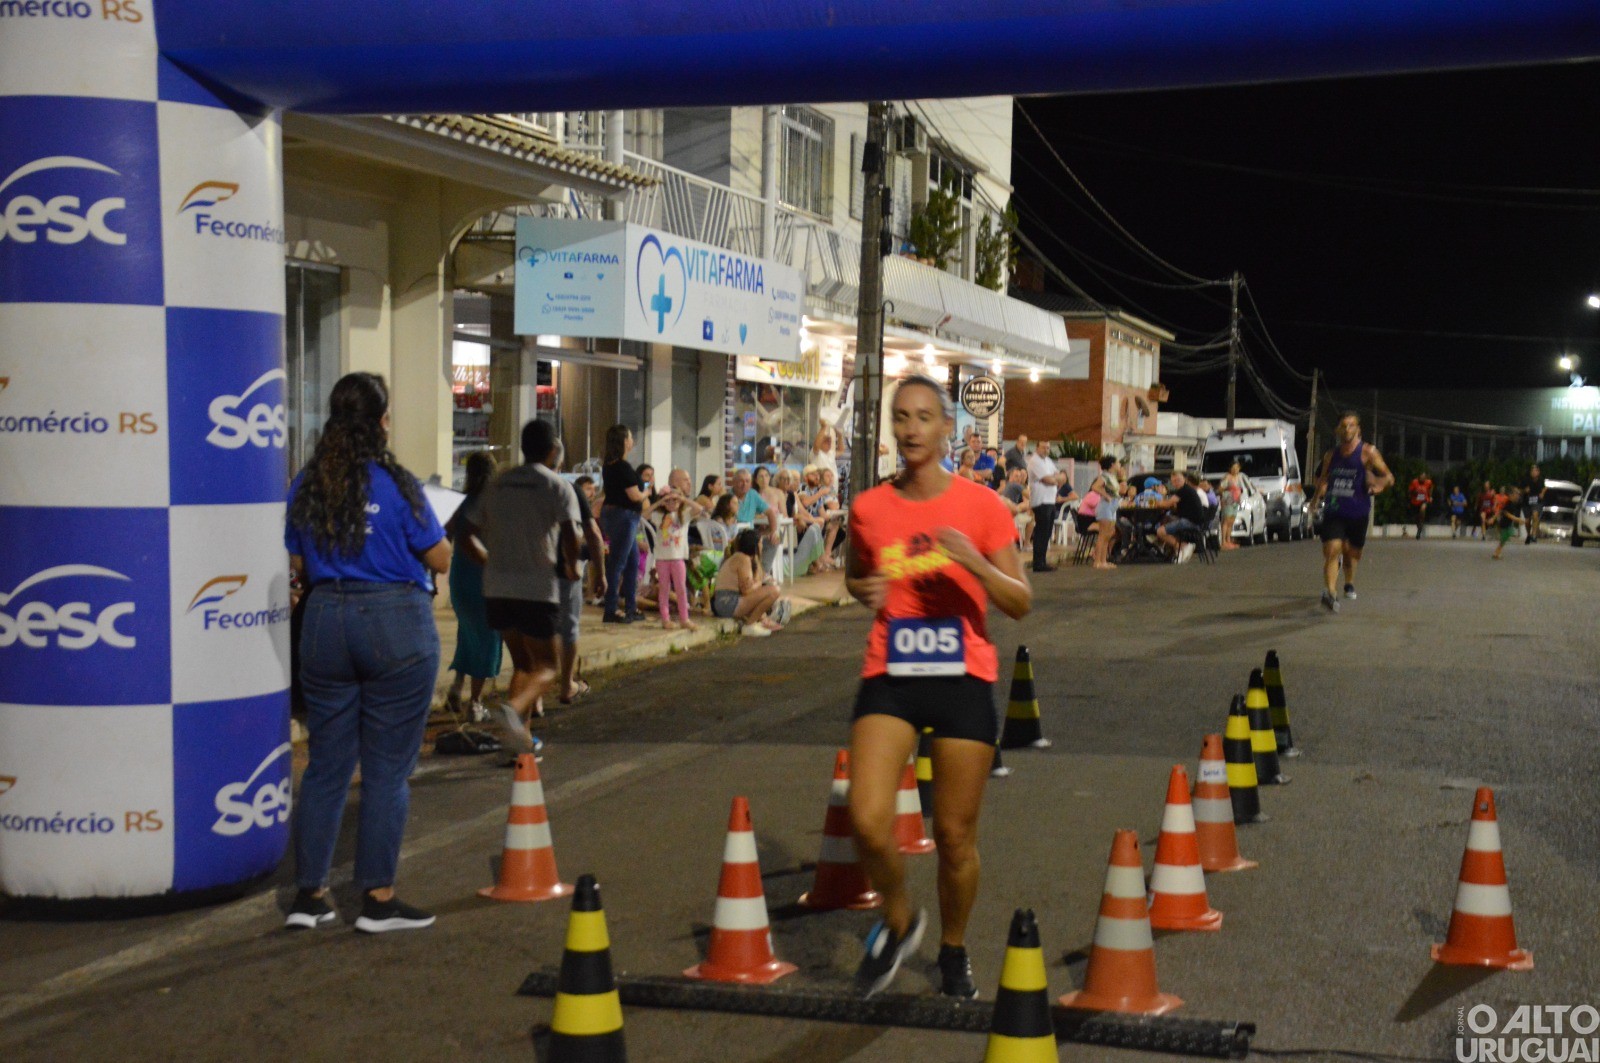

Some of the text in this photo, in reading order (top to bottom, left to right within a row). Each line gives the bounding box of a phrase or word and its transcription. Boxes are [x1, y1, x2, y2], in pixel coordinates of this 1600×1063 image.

[102, 0, 143, 23] RS
[0, 194, 127, 246] esc
[550, 250, 619, 265] VITAFARMA
[685, 245, 765, 296] VITAFARMA
[118, 411, 159, 434] RS
[895, 626, 960, 654] 005
[0, 809, 164, 833] comércio RS
